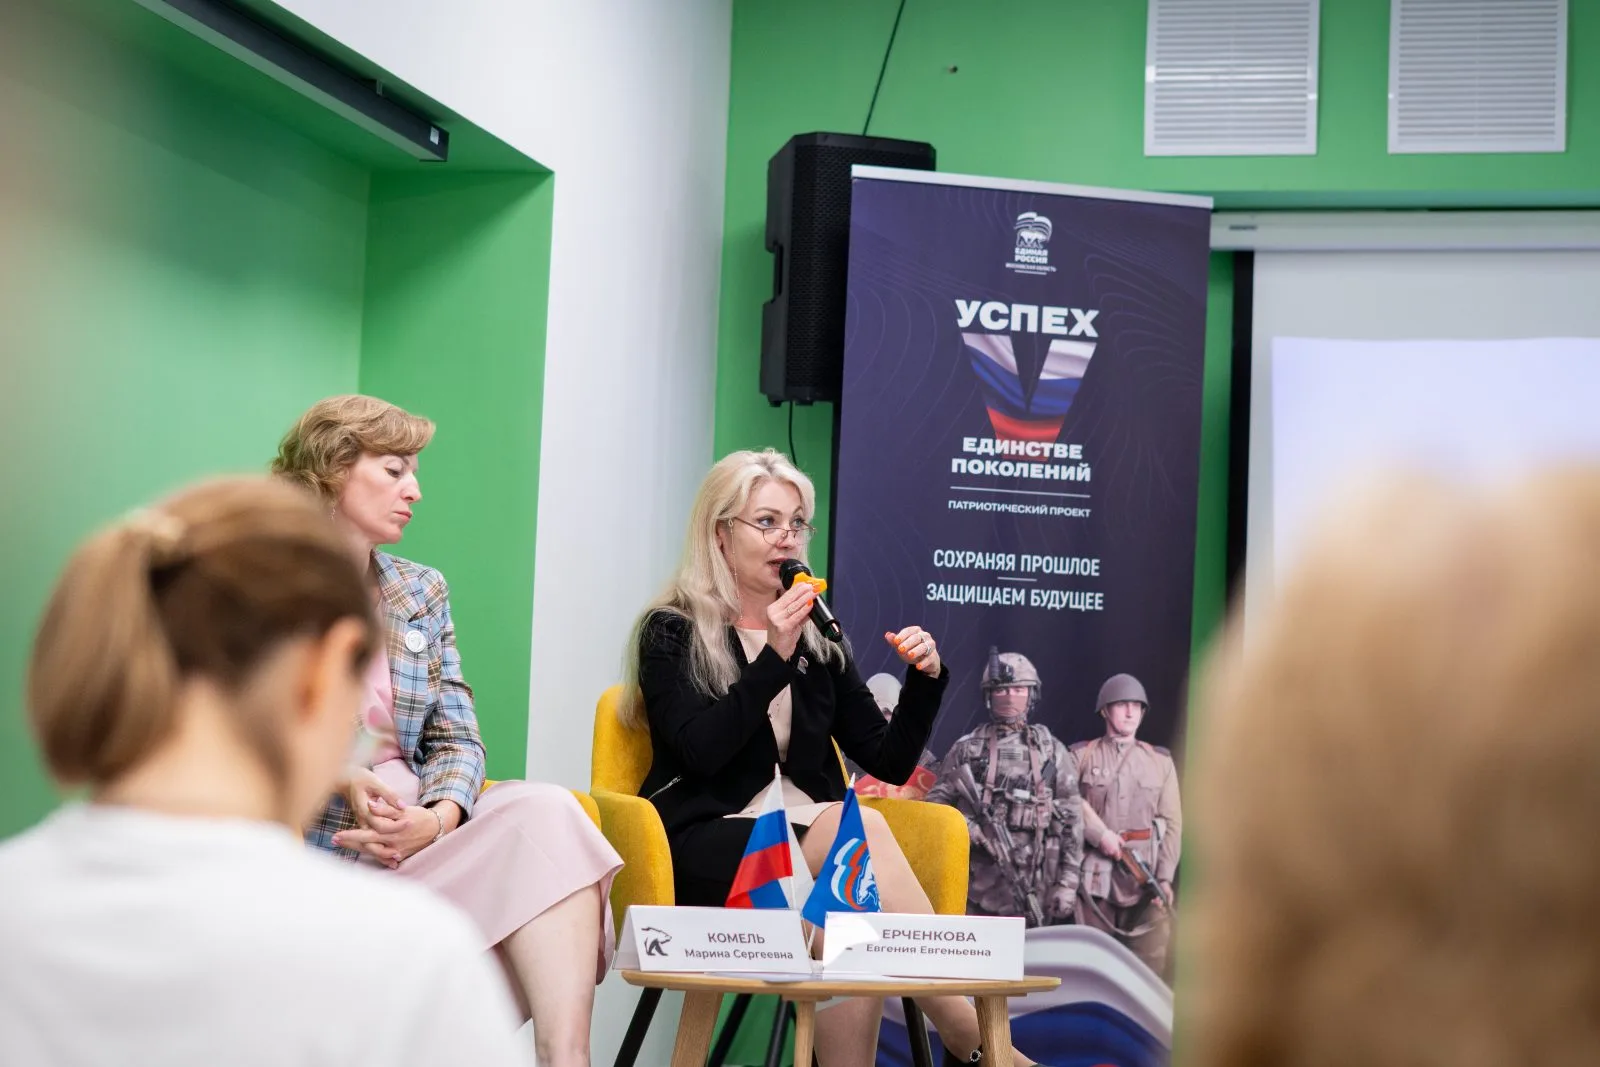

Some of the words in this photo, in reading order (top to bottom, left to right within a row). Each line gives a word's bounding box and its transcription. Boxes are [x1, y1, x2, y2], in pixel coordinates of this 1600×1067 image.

[1014, 254, 1049, 264] РОССИЯ
[955, 299, 1100, 338] УСПЕХ
[962, 437, 1083, 460] ЕДИНСТВЕ
[951, 458, 1092, 482] ПОКОЛЕНИЙ
[948, 500, 1048, 515] ПАТРИОТИЧЕСКИЙ
[1049, 506, 1092, 518] ПРОЕКТ
[933, 549, 1016, 572] СОХРАНЯЯ
[1020, 554, 1101, 577] ПРОШЛОЕ
[926, 583, 1026, 606] ЗАЩИЩАЕМ
[1030, 589, 1105, 612] БУДУЩЕЕ
[707, 932, 766, 945] КОМЕЛЬ
[882, 929, 977, 943] ЕРЧЕНКОВА
[684, 949, 731, 961] Марина
[733, 949, 794, 961] Сергеевна
[866, 943, 917, 955] Евгения
[920, 945, 991, 957] Евгеньевна
